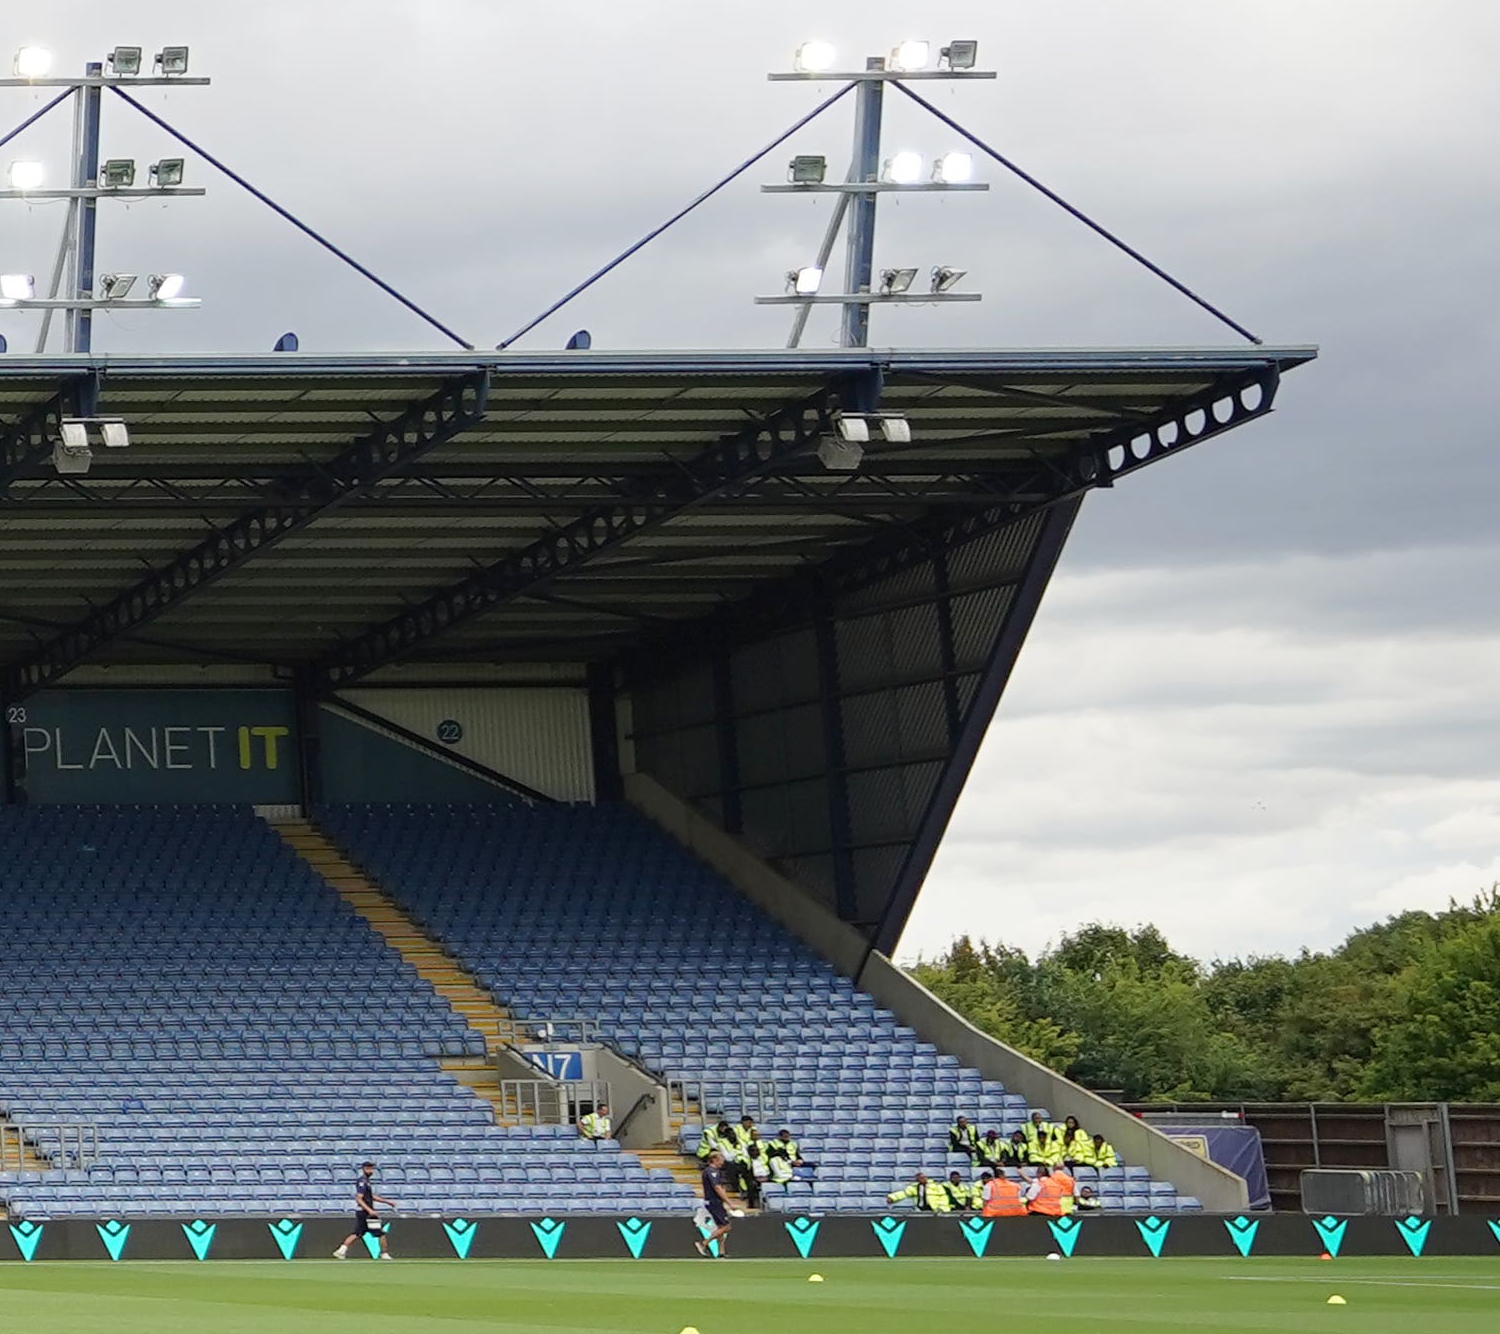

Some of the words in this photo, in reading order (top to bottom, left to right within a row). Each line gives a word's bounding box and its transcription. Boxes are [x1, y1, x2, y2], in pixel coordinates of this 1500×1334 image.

[8, 707, 27, 723] 23
[441, 724, 459, 740] 22
[23, 727, 226, 769] PLANET
[237, 726, 289, 770] IT
[531, 1053, 572, 1081] N7
